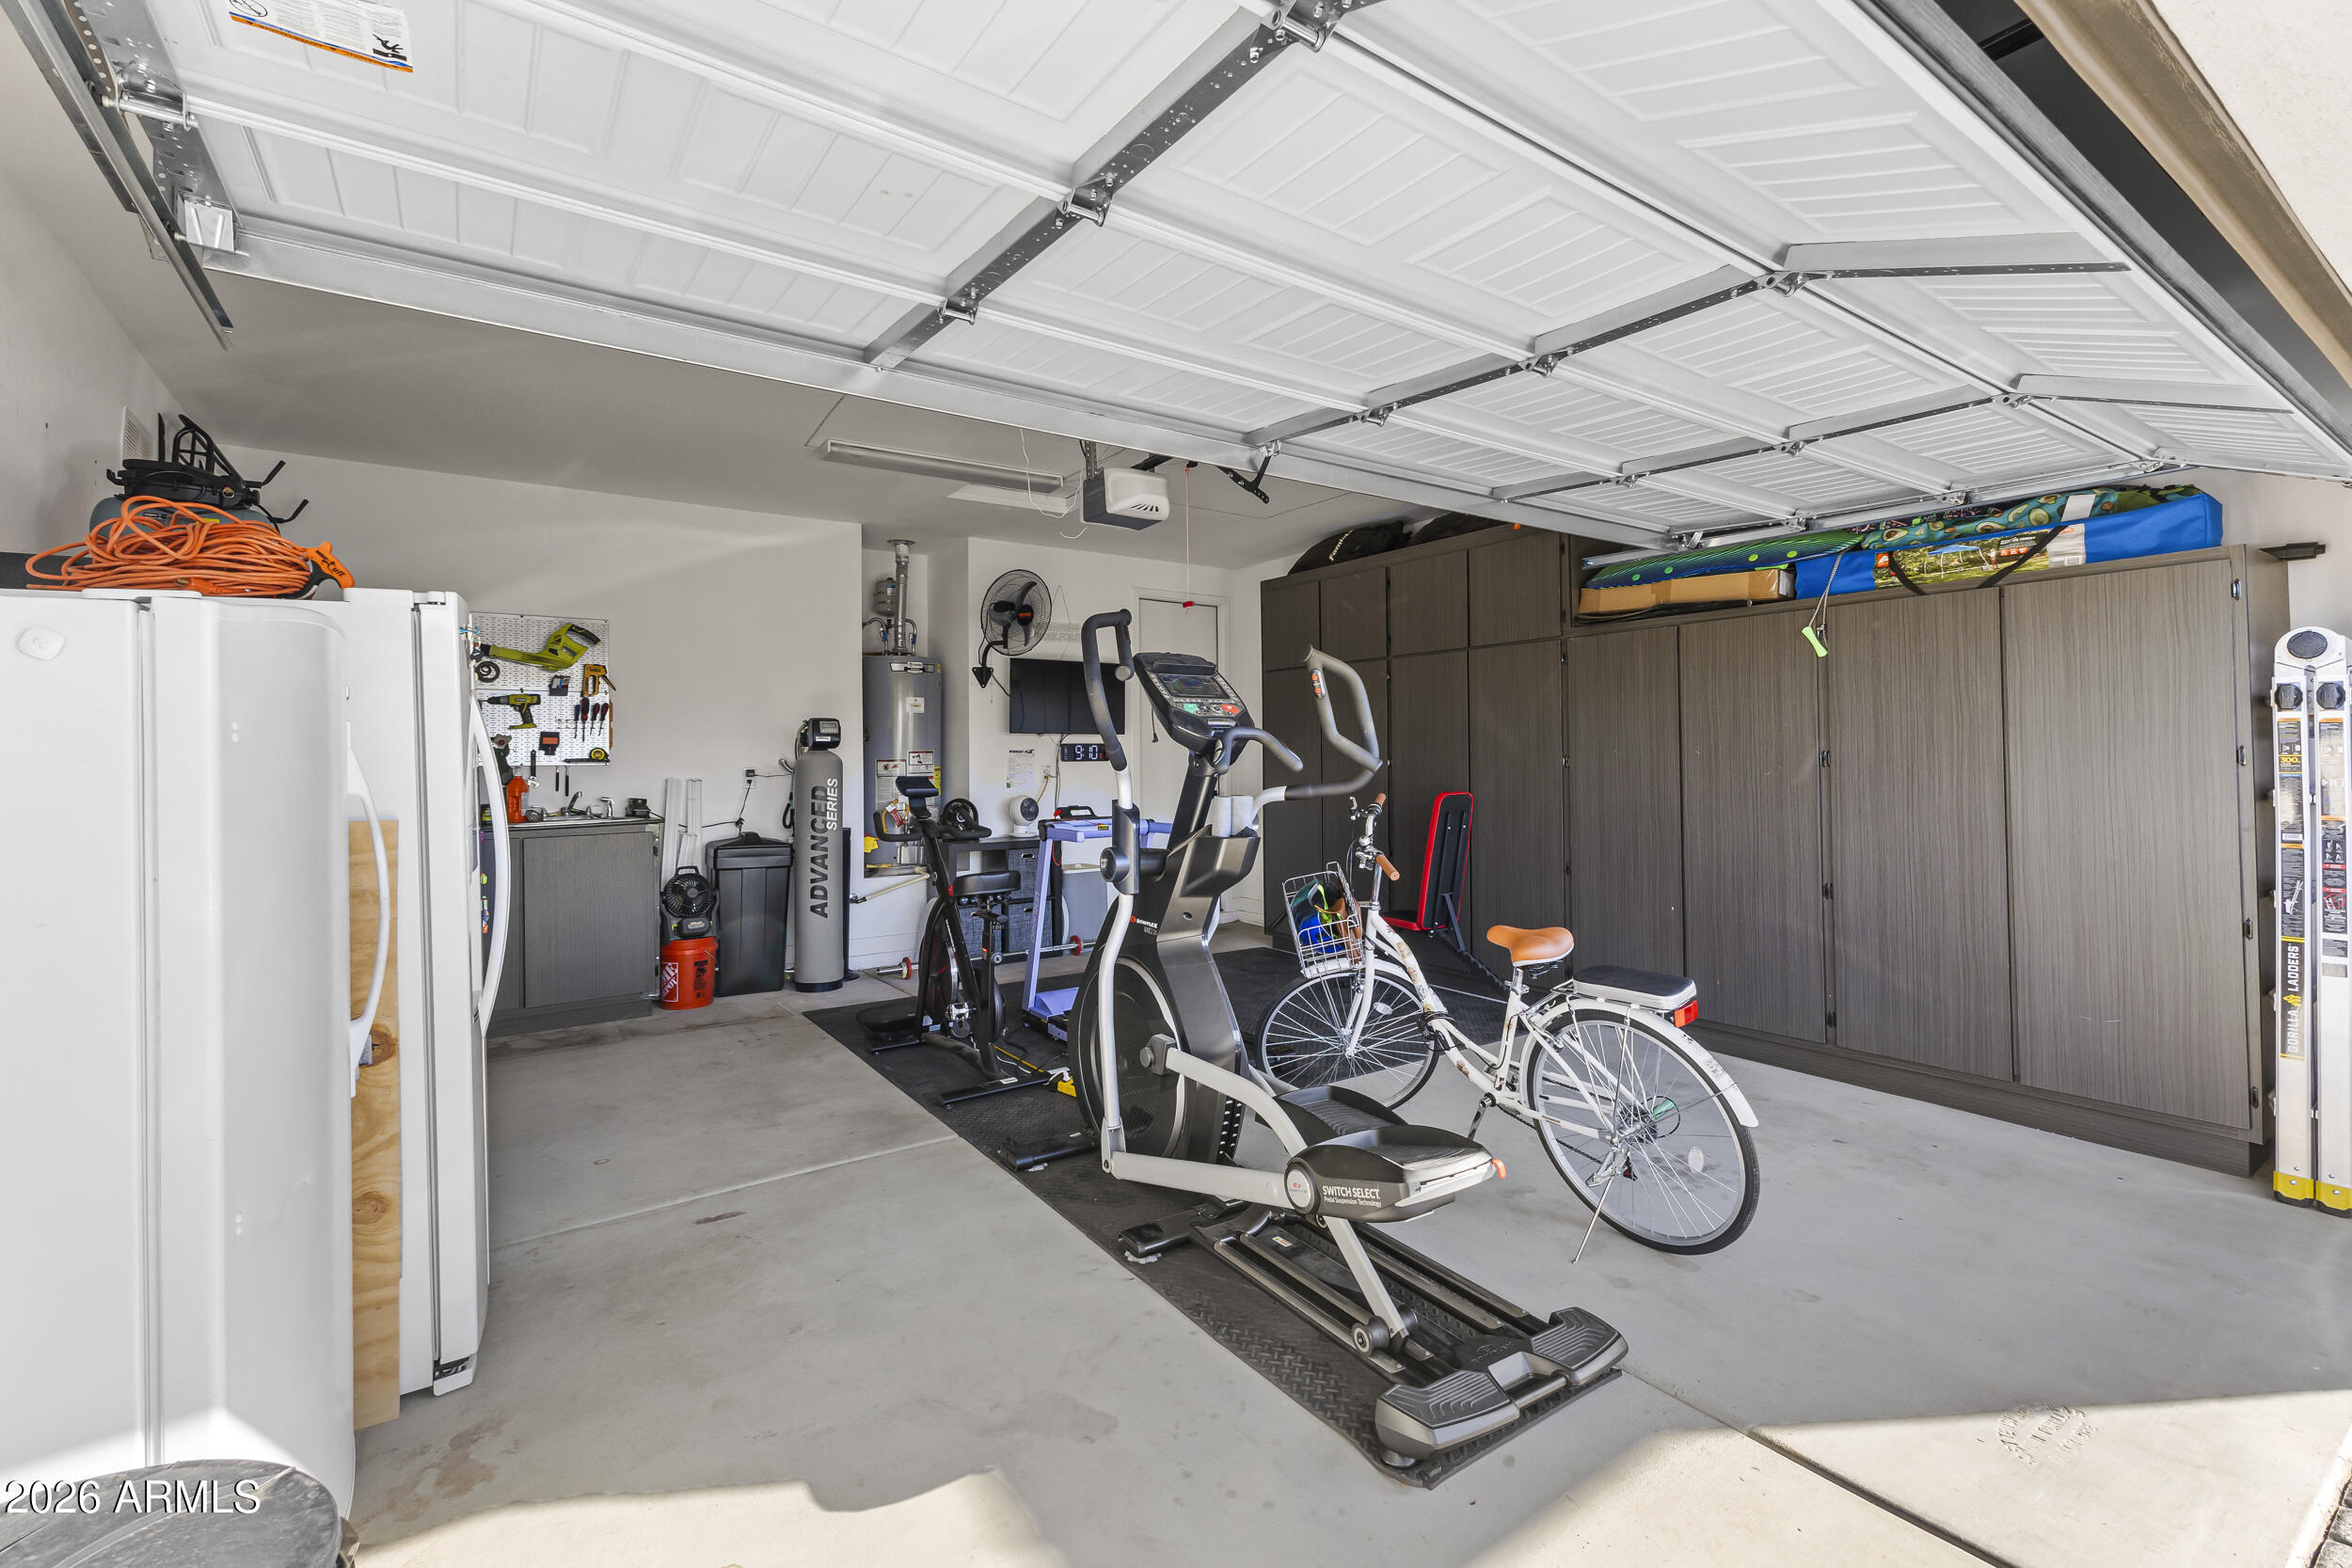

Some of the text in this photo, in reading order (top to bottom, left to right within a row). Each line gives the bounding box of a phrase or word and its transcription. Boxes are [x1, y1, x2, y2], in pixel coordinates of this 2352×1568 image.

[1074, 745, 1098, 760] 9:10
[827, 777, 838, 831] SERIES
[810, 785, 829, 919] ADVANCED
[1136, 919, 1157, 928] BOWFLEX
[2287, 944, 2299, 992] LADDERS
[2287, 1008, 2299, 1053] GORILLA
[1322, 1185, 1380, 1199] SWITCH SELECT
[1358, 1198, 1382, 1208] Technology
